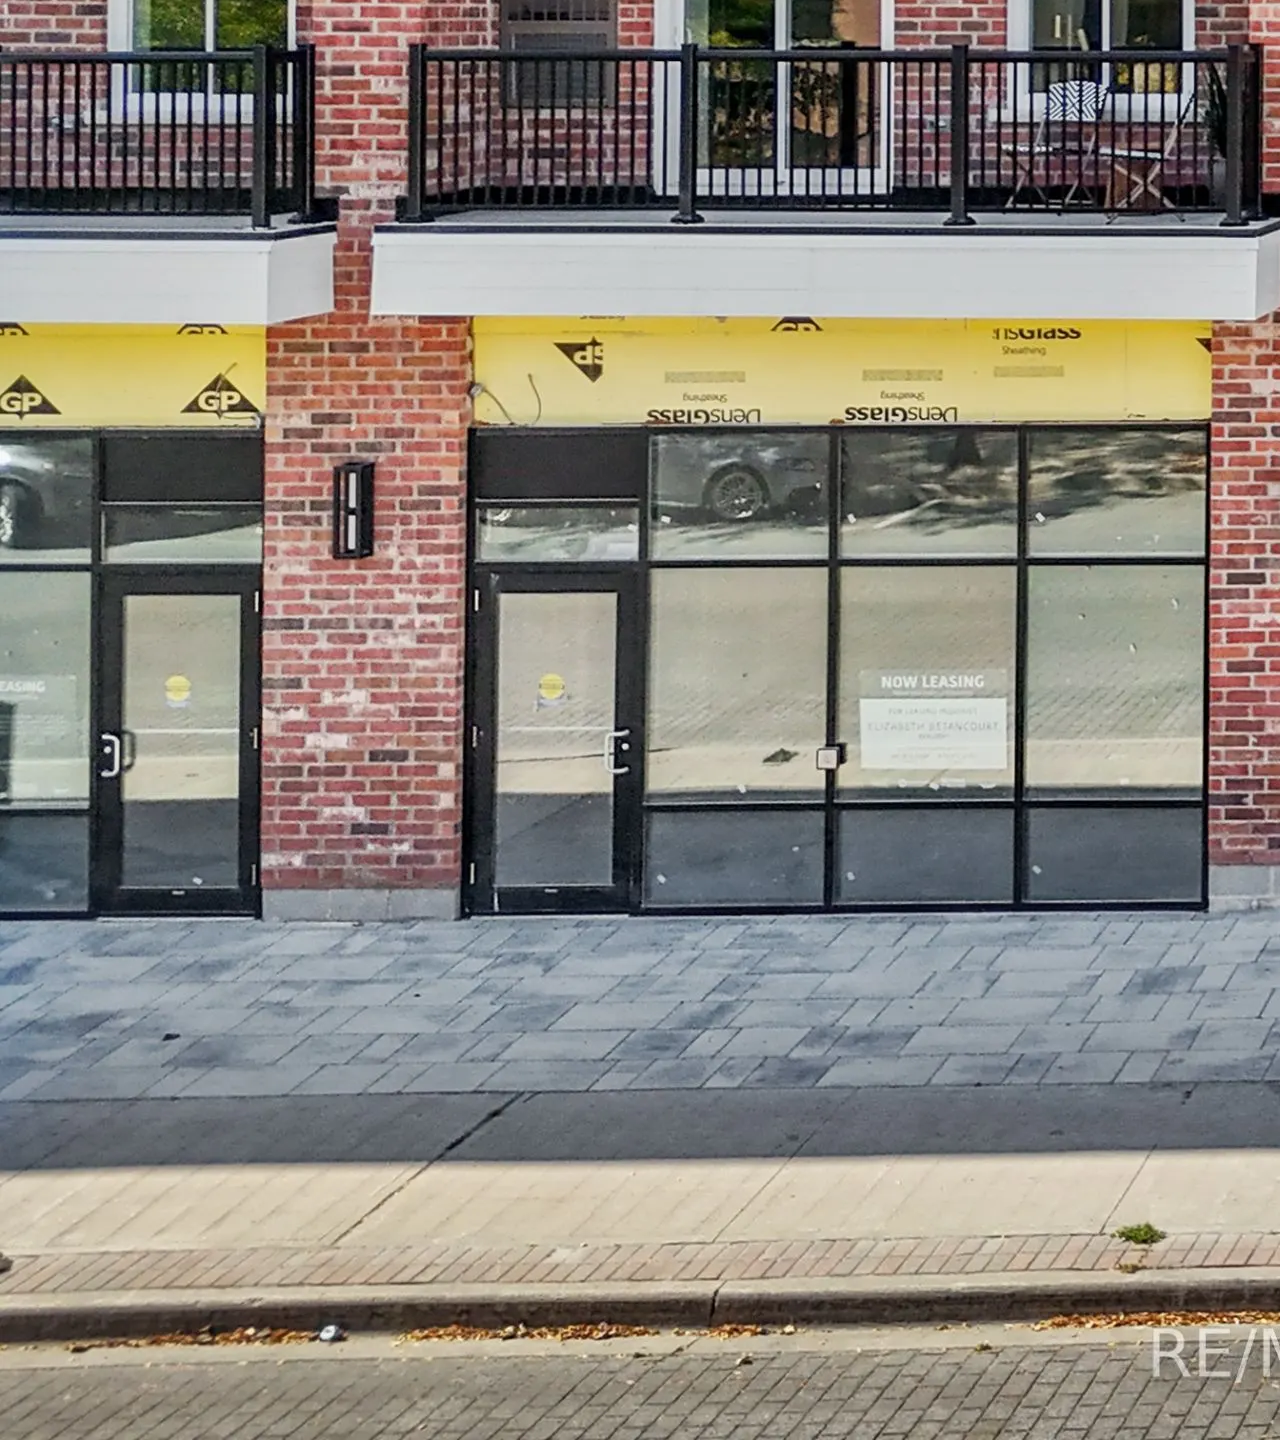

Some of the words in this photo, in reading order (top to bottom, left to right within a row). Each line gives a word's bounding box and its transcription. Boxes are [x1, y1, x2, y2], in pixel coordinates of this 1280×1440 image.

[1001, 344, 1047, 356] Sheathing
[197, 390, 242, 412] GP
[682, 393, 728, 404] Sheathing
[880, 391, 925, 402] Sheathing
[647, 409, 761, 424] DensGlass
[845, 407, 958, 423] DensGlass
[881, 676, 918, 689] NOW
[922, 674, 985, 688] LEASING
